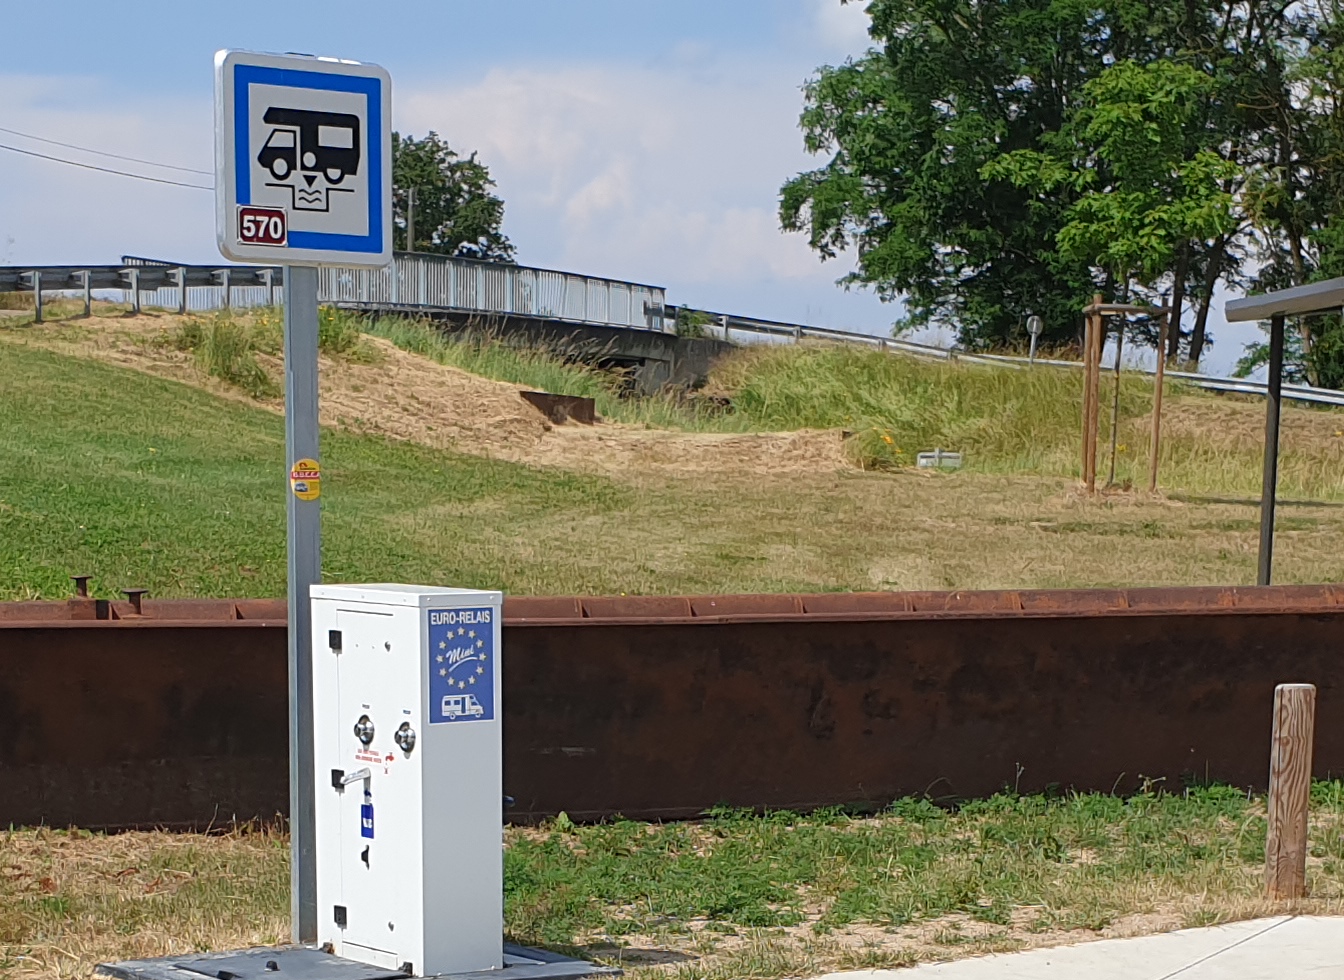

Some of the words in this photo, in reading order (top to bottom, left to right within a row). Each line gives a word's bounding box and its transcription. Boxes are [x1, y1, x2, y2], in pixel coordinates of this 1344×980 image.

[242, 215, 283, 239] 570
[430, 610, 491, 625] EURO-RELAIS
[445, 645, 475, 664] Mini
